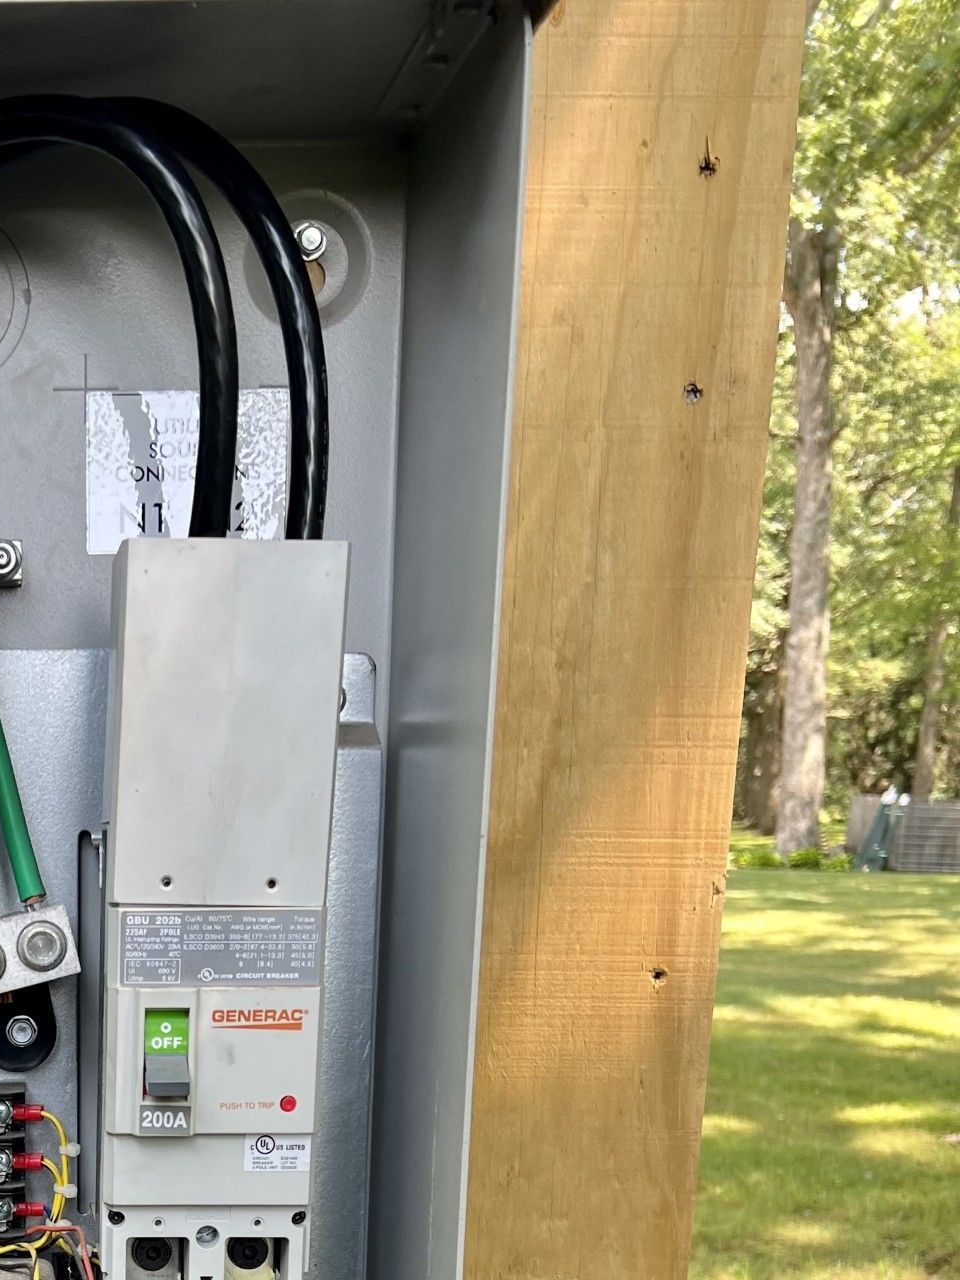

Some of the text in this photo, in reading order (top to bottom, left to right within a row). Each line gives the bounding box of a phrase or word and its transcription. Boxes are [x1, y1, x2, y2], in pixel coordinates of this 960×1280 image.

[126, 916, 150, 924] GBU
[156, 916, 181, 924] 202b
[151, 1036, 182, 1049] OFF
[220, 1101, 275, 1110] PUSH TO TRIP
[142, 1111, 187, 1128] 200A
